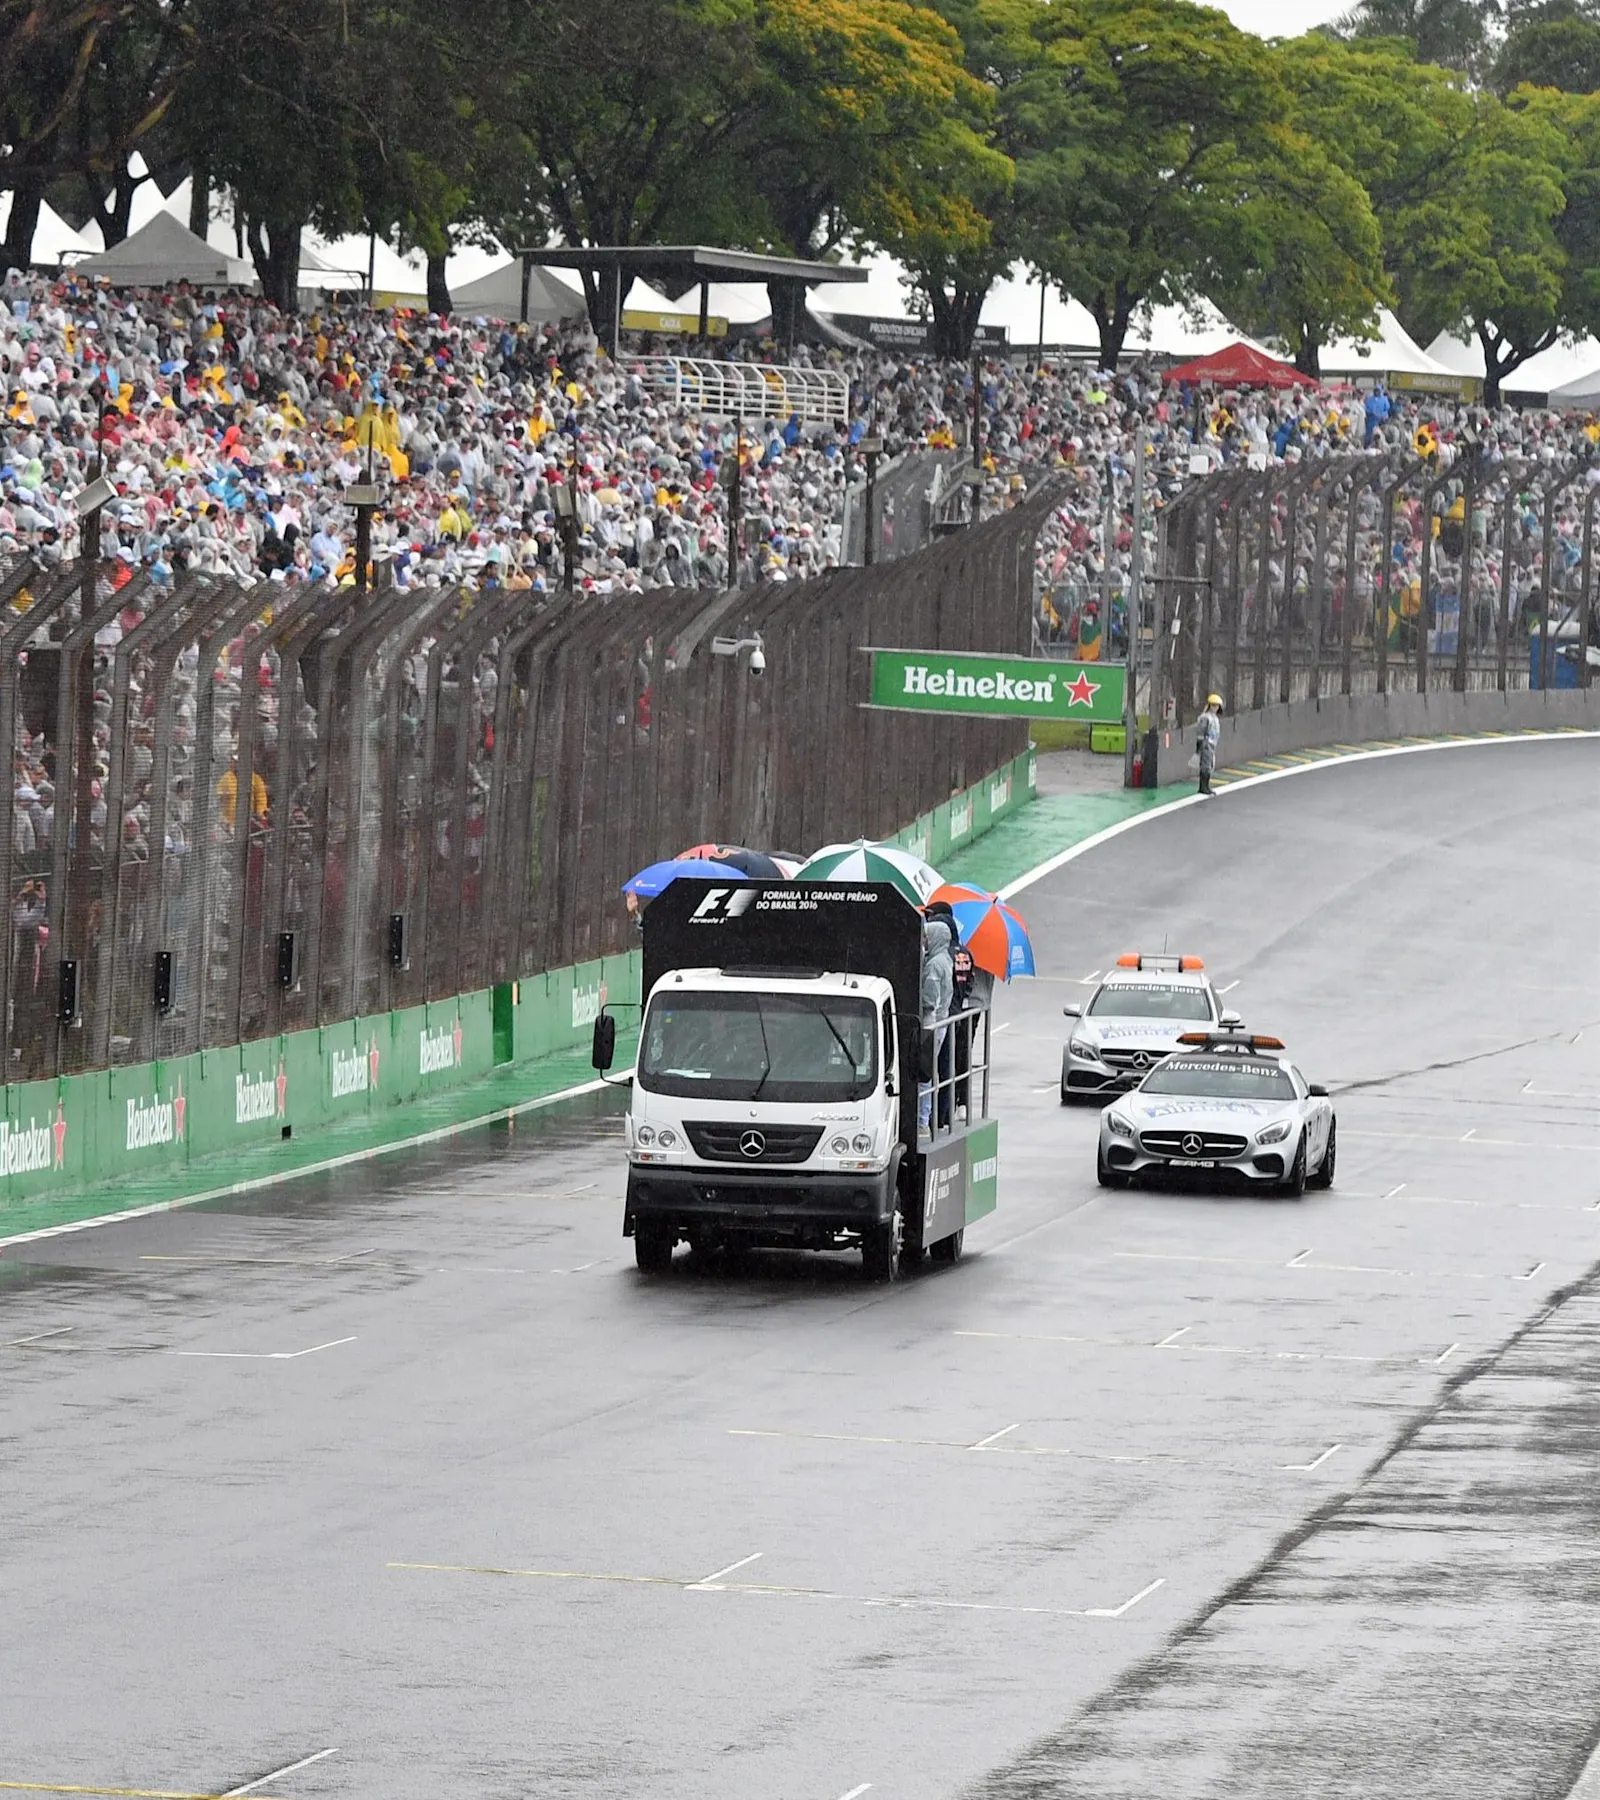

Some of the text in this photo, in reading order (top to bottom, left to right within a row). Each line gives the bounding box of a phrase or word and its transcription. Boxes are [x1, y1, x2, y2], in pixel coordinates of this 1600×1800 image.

[903, 666, 1054, 702] Heineken
[693, 889, 758, 916] F1
[756, 901, 818, 910] DO BRASIL 2016
[763, 891, 878, 902] FORMULA 1 GRANDE PRÊMIO
[1106, 984, 1201, 995] Mercedes-Benz
[1165, 1061, 1279, 1077] Mercedes-Benz
[236, 1071, 275, 1123] Heineken
[126, 1093, 173, 1150] Heineken
[0, 1117, 51, 1176] Heineken
